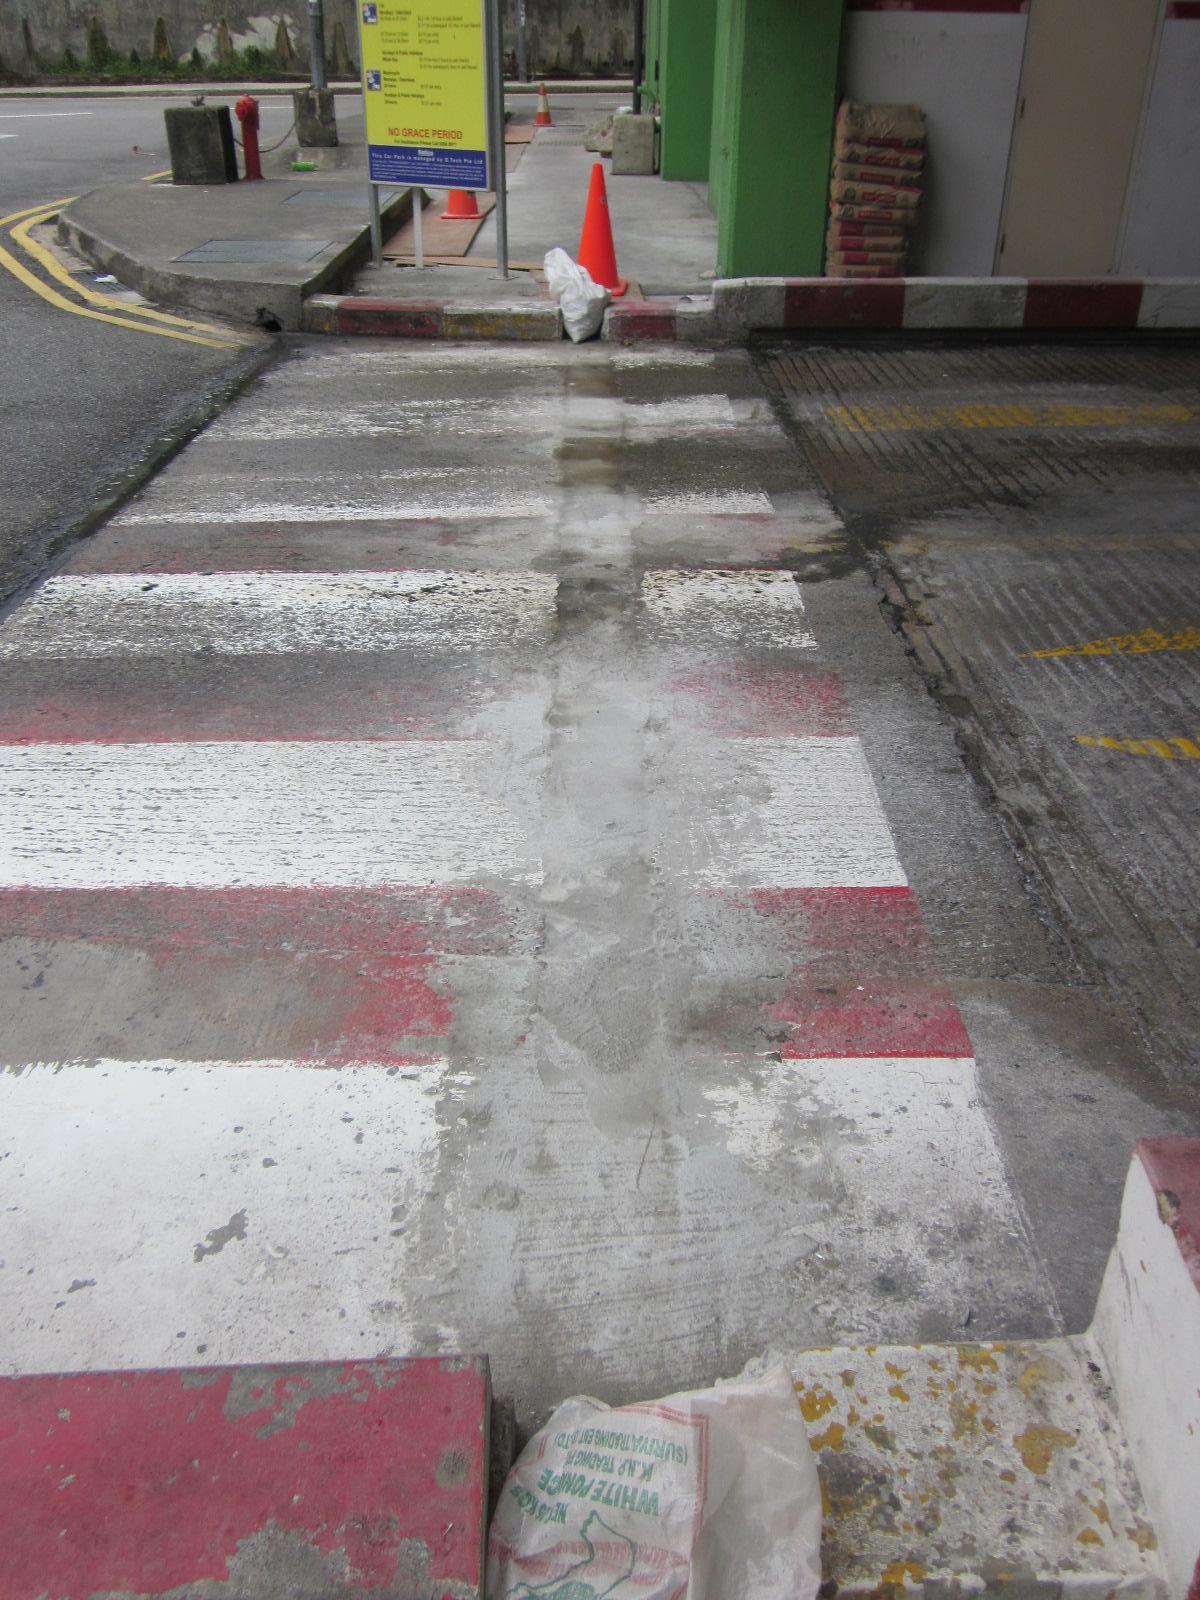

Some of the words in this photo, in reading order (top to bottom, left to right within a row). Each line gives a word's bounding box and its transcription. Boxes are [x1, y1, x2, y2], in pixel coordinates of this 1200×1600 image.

[388, 127, 400, 137] NO
[401, 127, 430, 138] GRACE
[431, 129, 463, 140] PERIOD
[591, 1480, 659, 1517] WHITE
